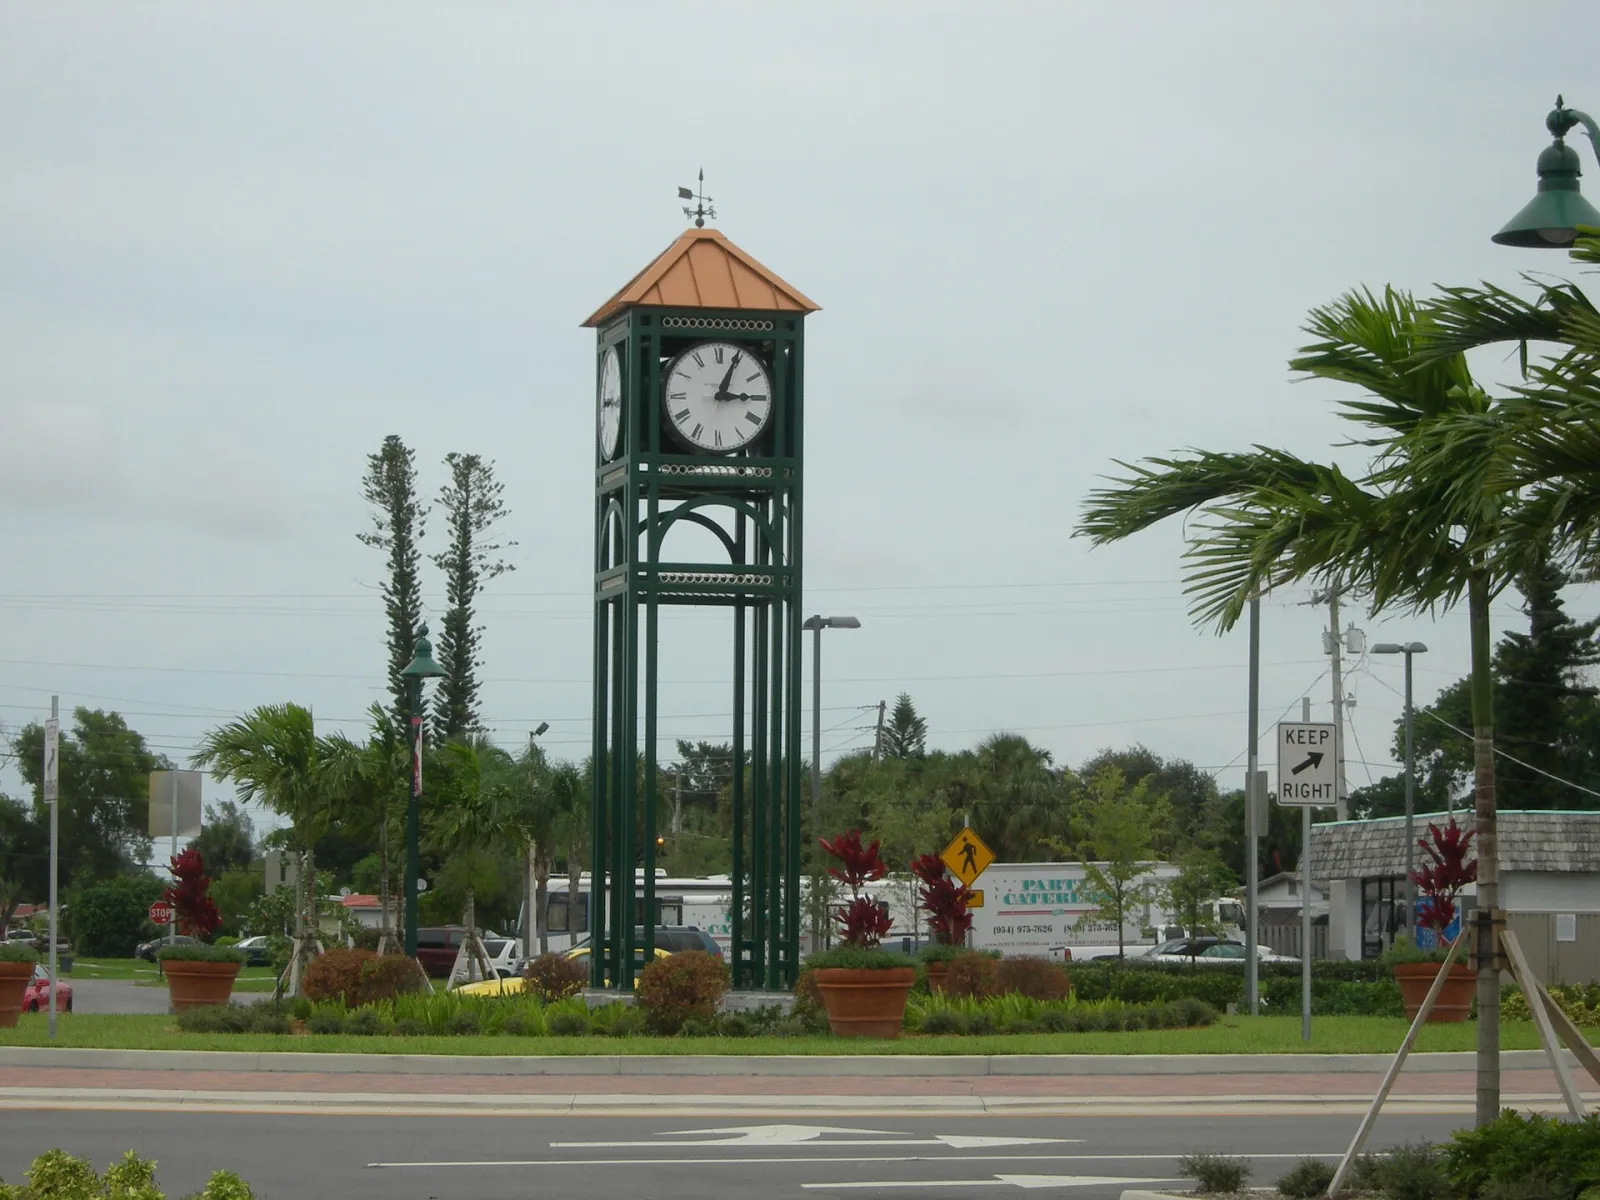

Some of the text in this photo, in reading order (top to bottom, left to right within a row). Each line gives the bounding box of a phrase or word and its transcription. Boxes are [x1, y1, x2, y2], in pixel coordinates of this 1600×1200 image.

[1285, 729, 1330, 745] KEEP
[1283, 782, 1333, 799] RIGHT
[1003, 892, 1114, 905] CATERE
[151, 908, 171, 918] STOP
[993, 925, 1014, 935] (954)
